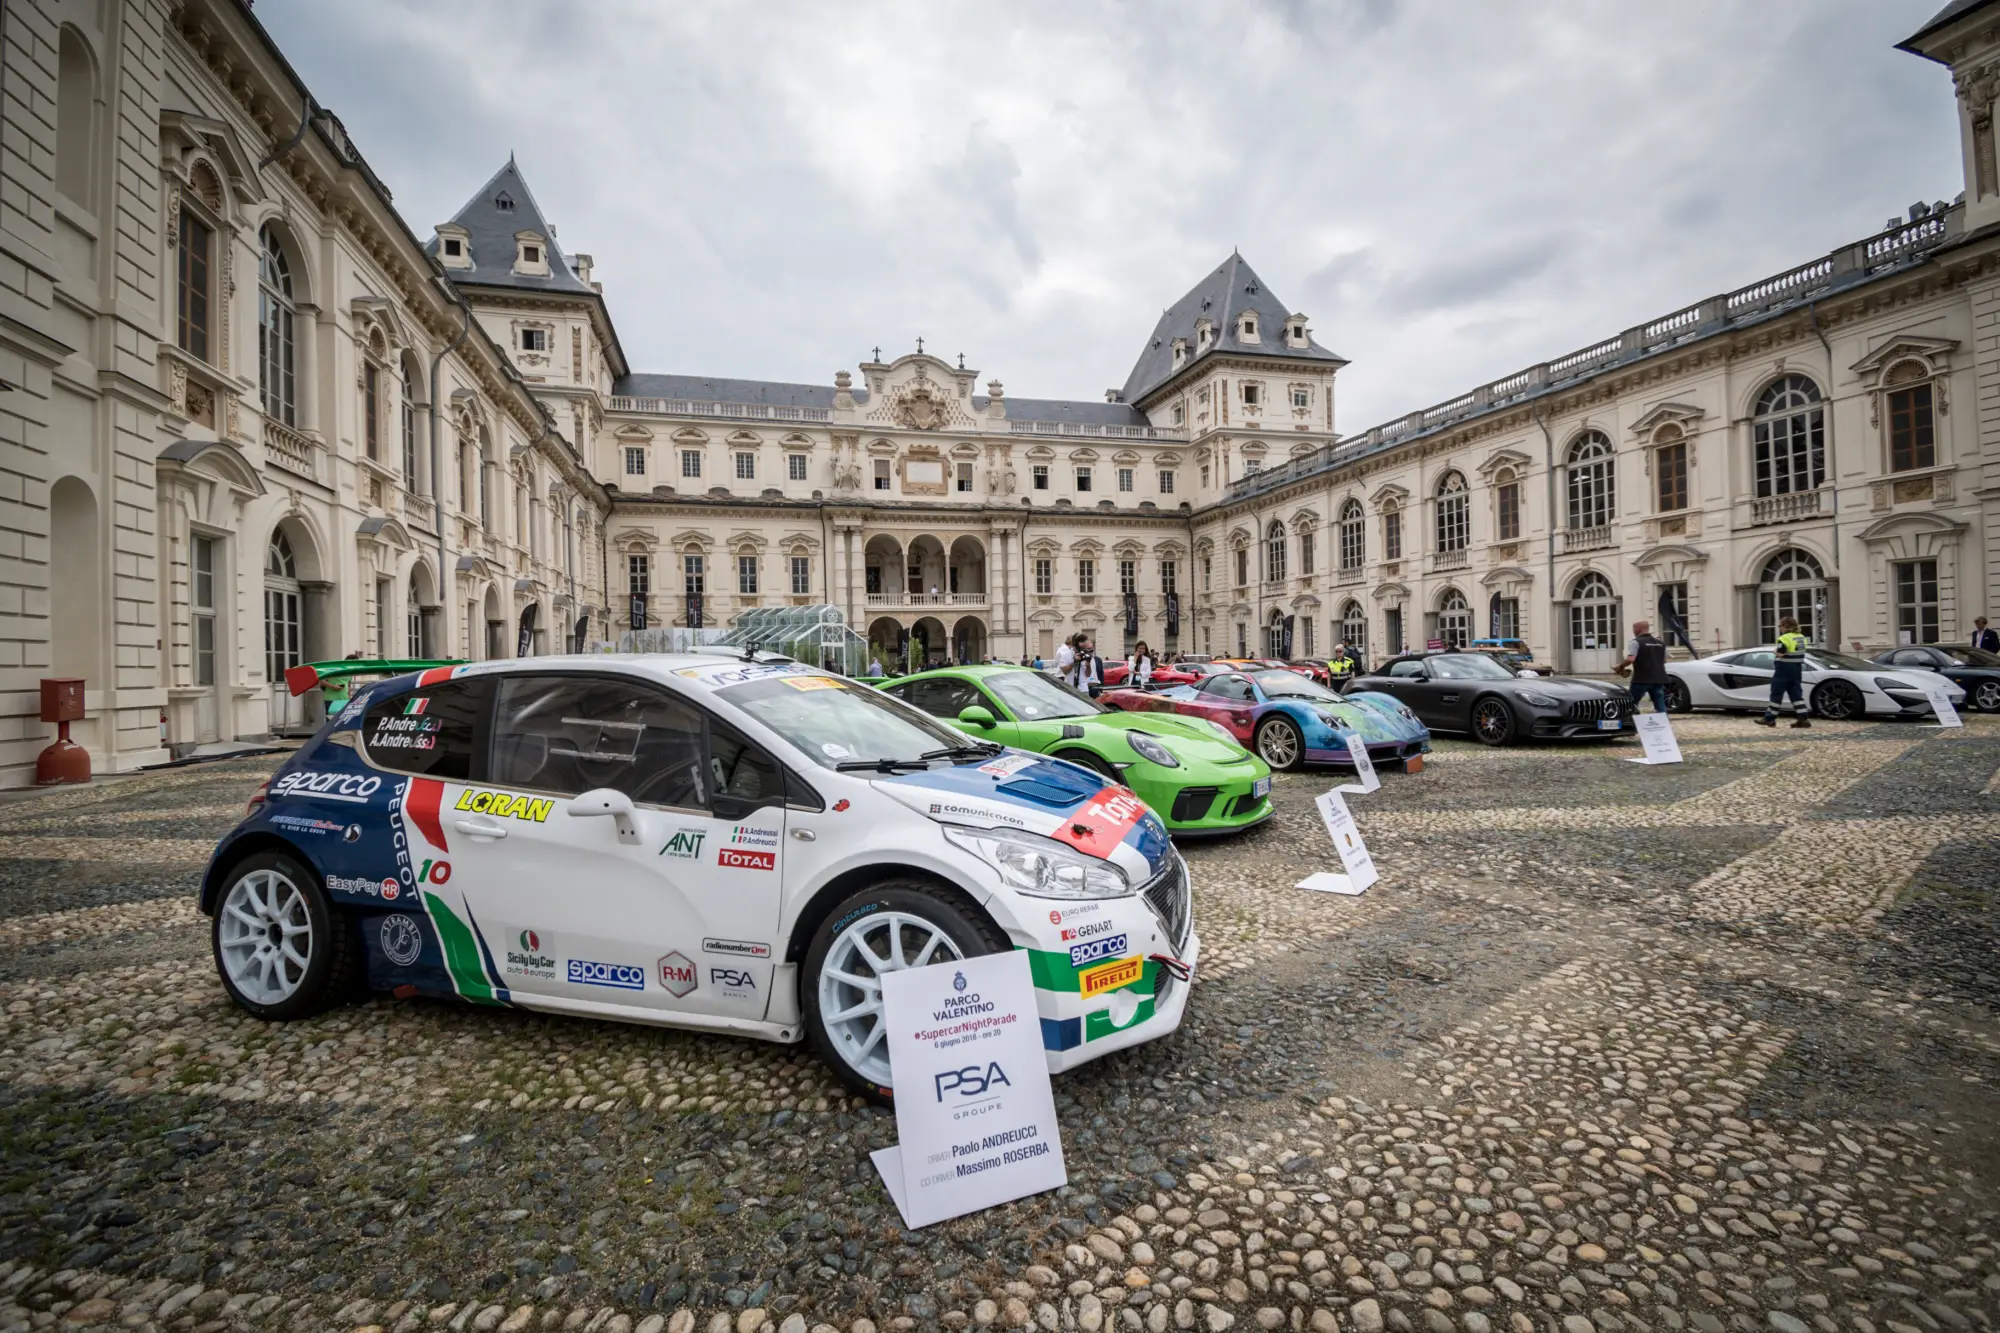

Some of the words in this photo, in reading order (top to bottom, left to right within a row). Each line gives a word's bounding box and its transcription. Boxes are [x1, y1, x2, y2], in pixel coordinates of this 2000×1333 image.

[272, 772, 381, 800] sparco
[454, 789, 555, 823] LORAN
[1088, 794, 1140, 826] TOTA
[388, 782, 418, 900] PEUGEOT
[659, 832, 705, 859] ANT
[418, 859, 451, 885] 10
[720, 851, 773, 868] TOTAL
[327, 875, 380, 896] EasyPay
[382, 883, 399, 895] HR
[1078, 920, 1113, 937] GENART
[1071, 936, 1127, 967] sparco
[506, 967, 523, 975] auto
[529, 968, 556, 980] europa
[568, 960, 643, 988] sparco
[663, 966, 692, 982] R-M
[711, 968, 756, 989] PSA
[1085, 961, 1138, 992] PIRELLI
[933, 1001, 995, 1022] VALENTINO
[944, 993, 981, 1009] PARCO
[914, 1013, 1017, 1041] #SupercarNightParade
[934, 1040, 939, 1049] 6
[940, 1036, 960, 1049] giugno
[961, 1033, 977, 1044] 2018
[982, 1031, 993, 1040] ore
[993, 1028, 1001, 1037] 20
[934, 1061, 1011, 1103] PSA
[953, 1103, 1002, 1121] GROUPE
[952, 1142, 980, 1157] Paolo
[982, 1125, 1037, 1150] ANDREUCCI
[956, 1156, 1001, 1178] Massimo
[1003, 1142, 1049, 1164] ROSERBA
